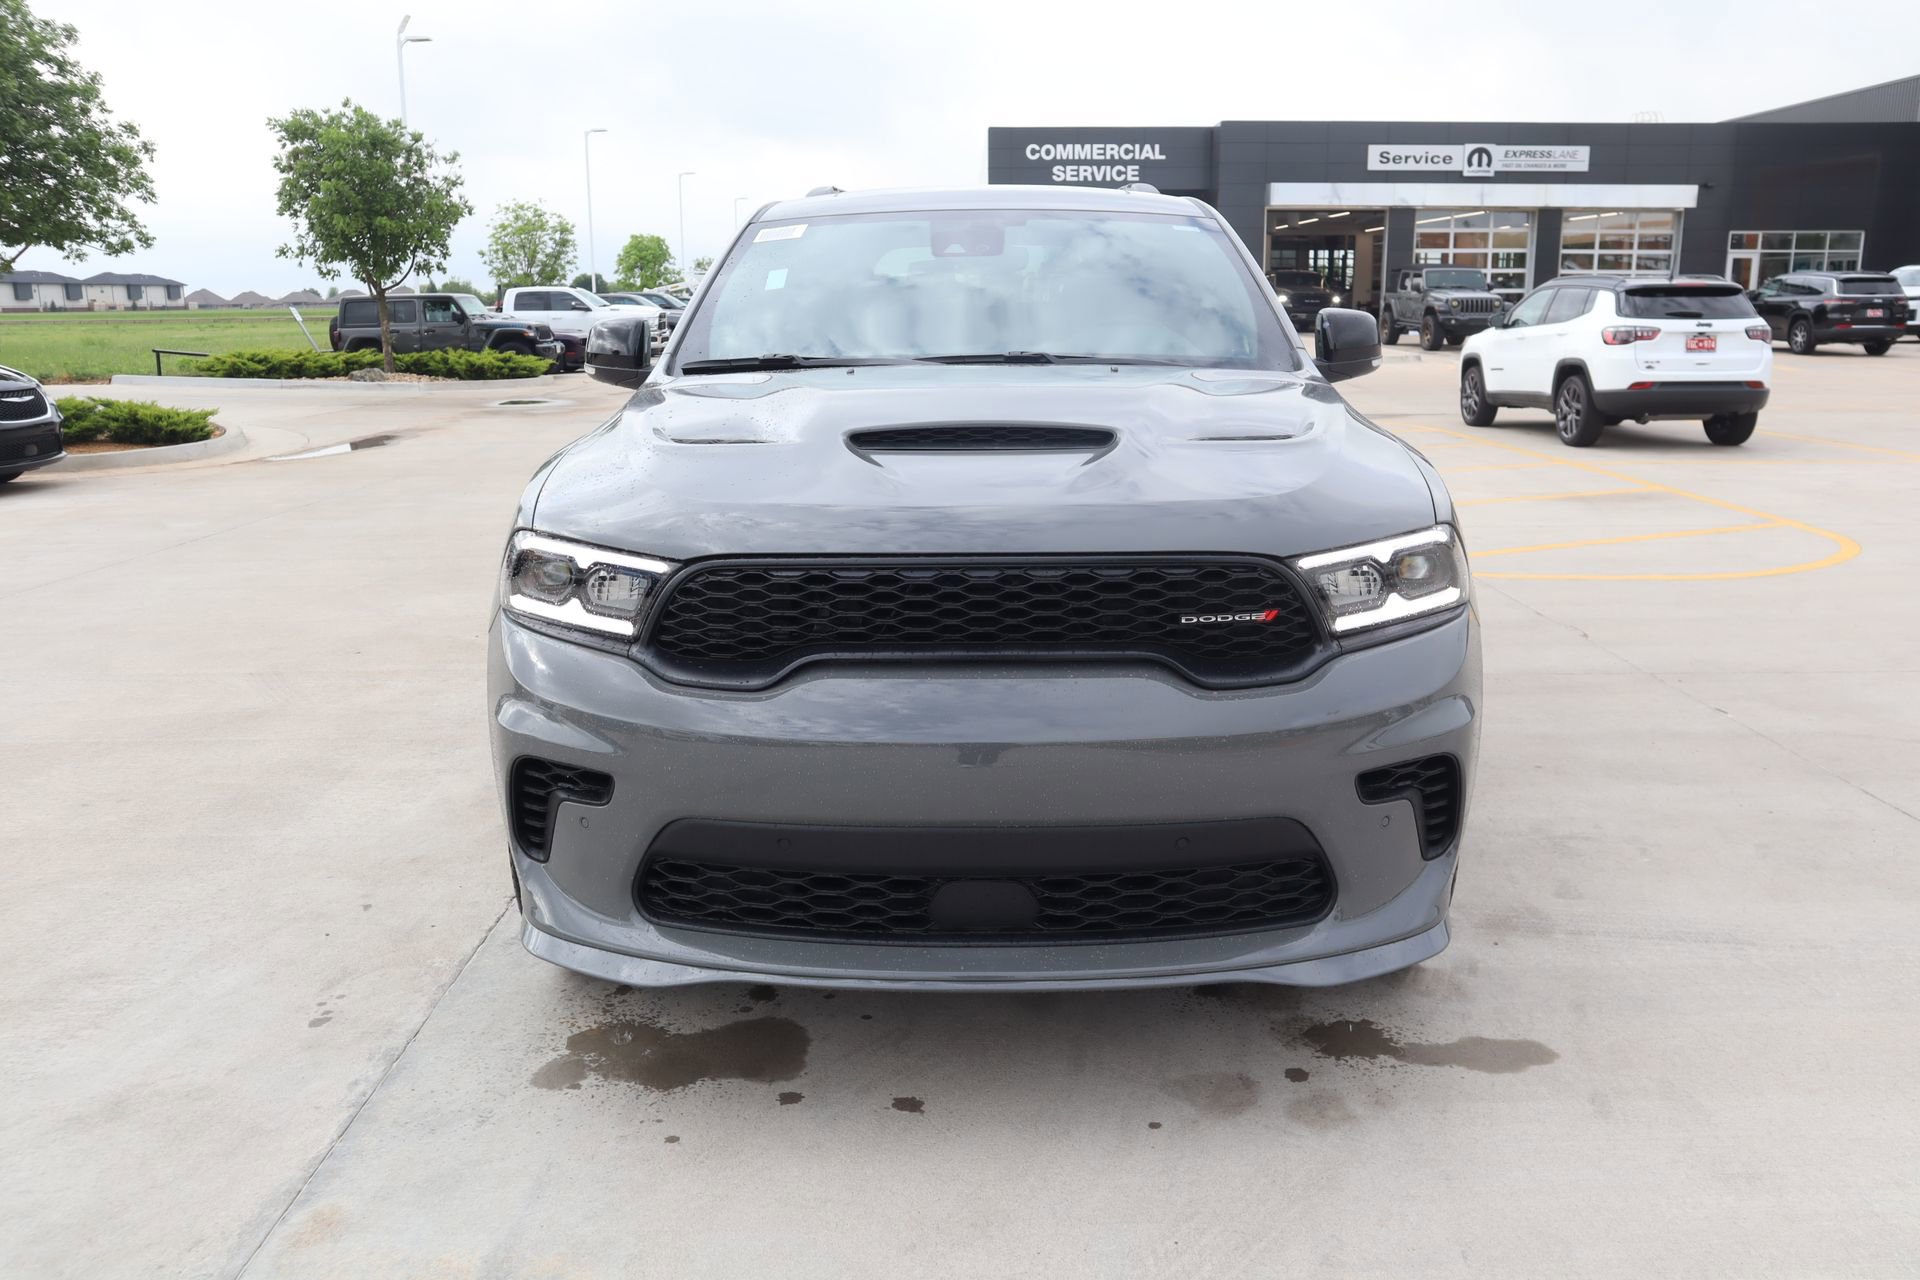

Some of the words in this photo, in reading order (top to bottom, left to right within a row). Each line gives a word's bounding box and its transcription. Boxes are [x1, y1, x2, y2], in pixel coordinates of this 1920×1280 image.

[1025, 143, 1166, 161] COMMERCIAL
[1379, 150, 1453, 165] Service
[1051, 165, 1140, 182] SERVICE
[1181, 612, 1266, 624] DODGE
